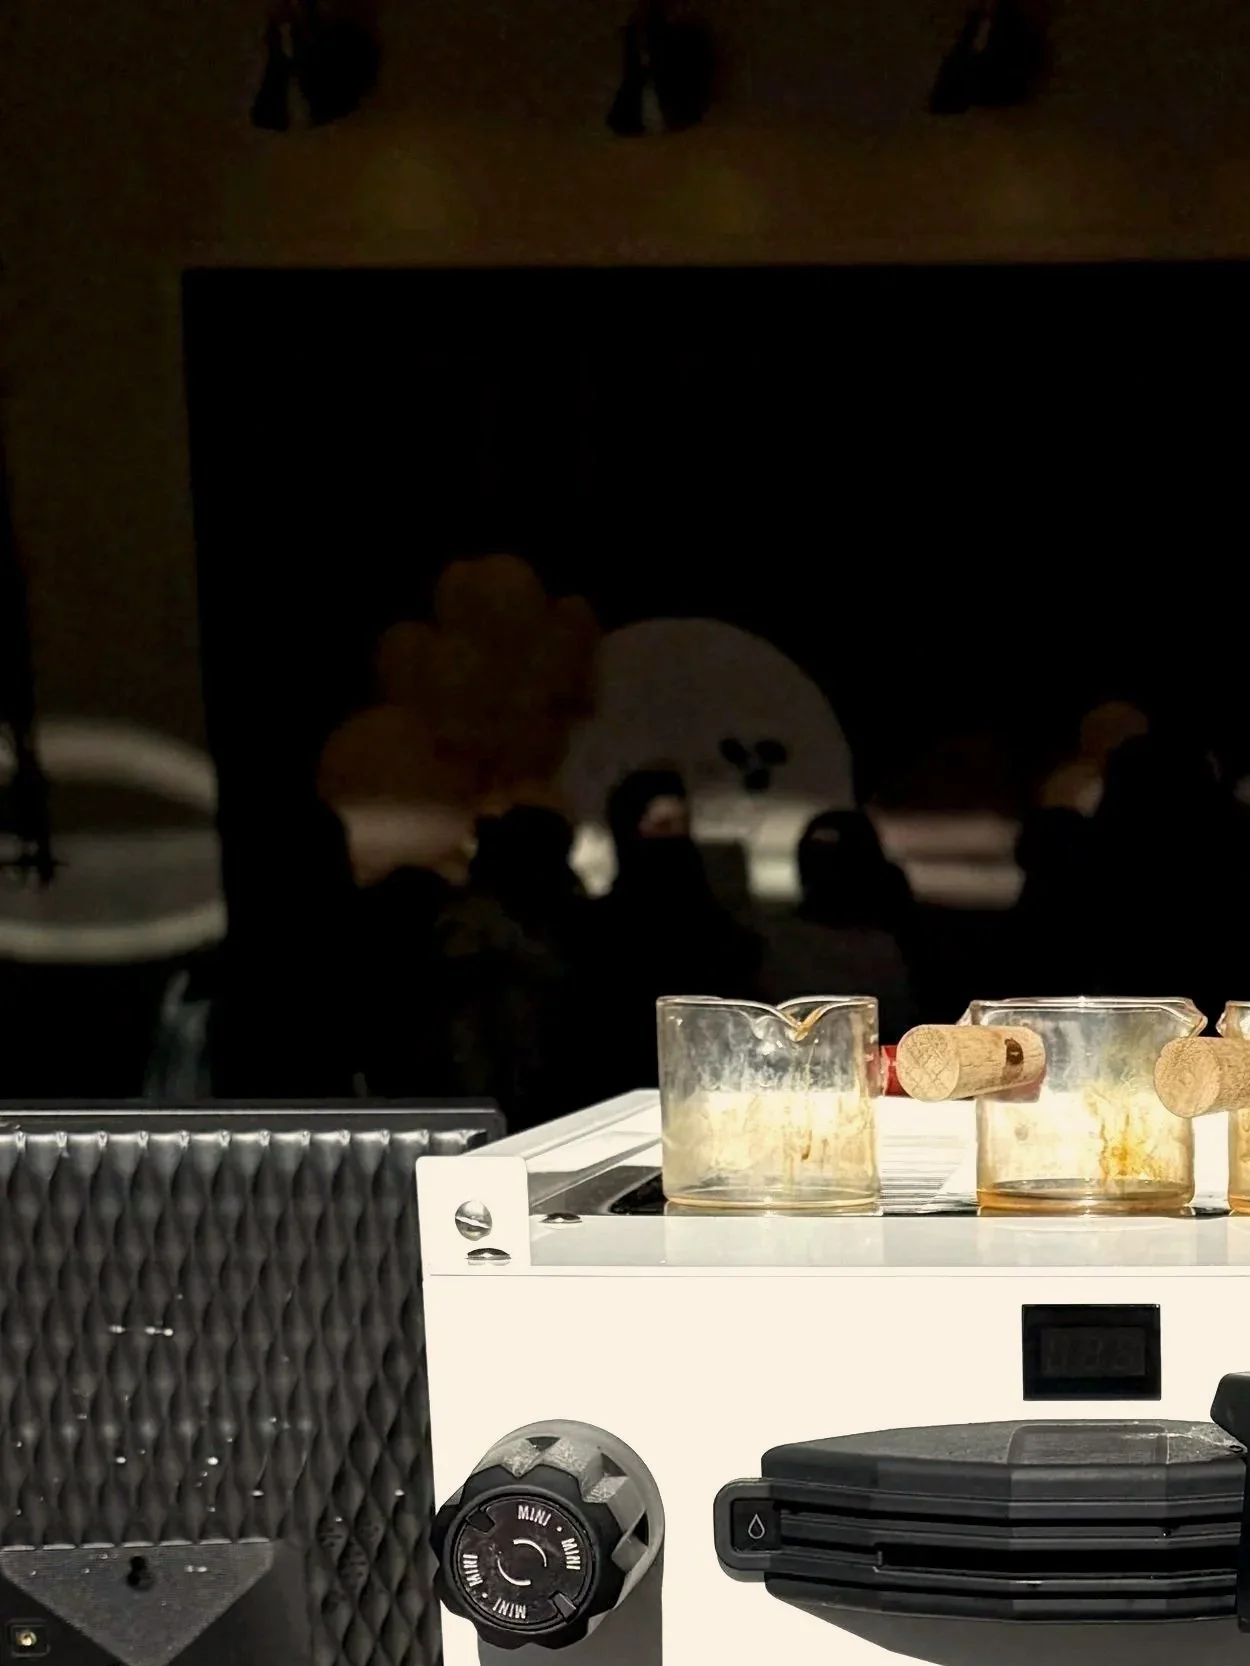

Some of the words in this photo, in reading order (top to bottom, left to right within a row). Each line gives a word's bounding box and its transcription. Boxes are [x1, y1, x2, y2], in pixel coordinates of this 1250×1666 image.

[517, 1505, 551, 1526] MINI
[561, 1538, 581, 1570] MINI
[462, 1554, 483, 1587] MINI
[492, 1598, 526, 1619] MINI
